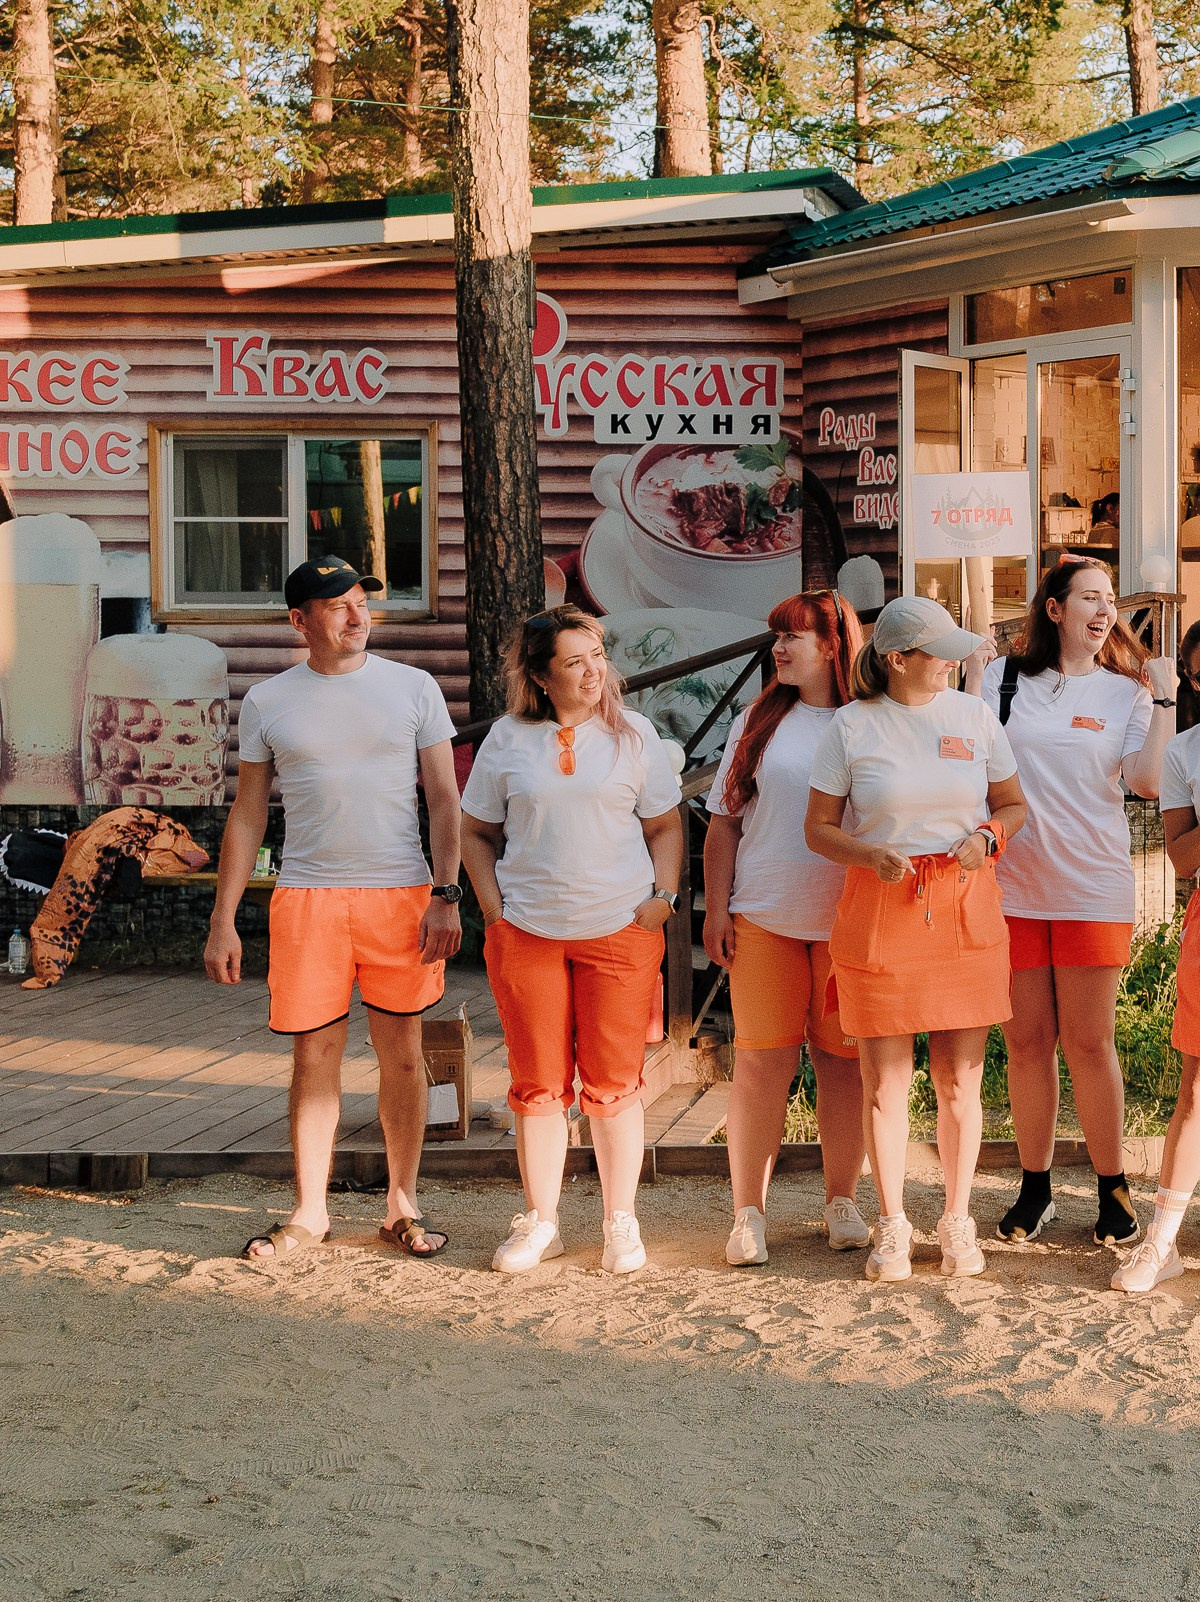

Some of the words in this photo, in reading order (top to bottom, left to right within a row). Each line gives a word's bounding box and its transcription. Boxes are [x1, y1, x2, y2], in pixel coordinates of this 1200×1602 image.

[212, 336, 384, 399] Квас
[610, 412, 772, 441] кухня
[819, 409, 876, 449] Рады
[858, 449, 897, 484] Вас
[931, 510, 941, 525] 7
[947, 507, 1013, 526] ОТРЯД
[944, 536, 976, 549] СМЕНА
